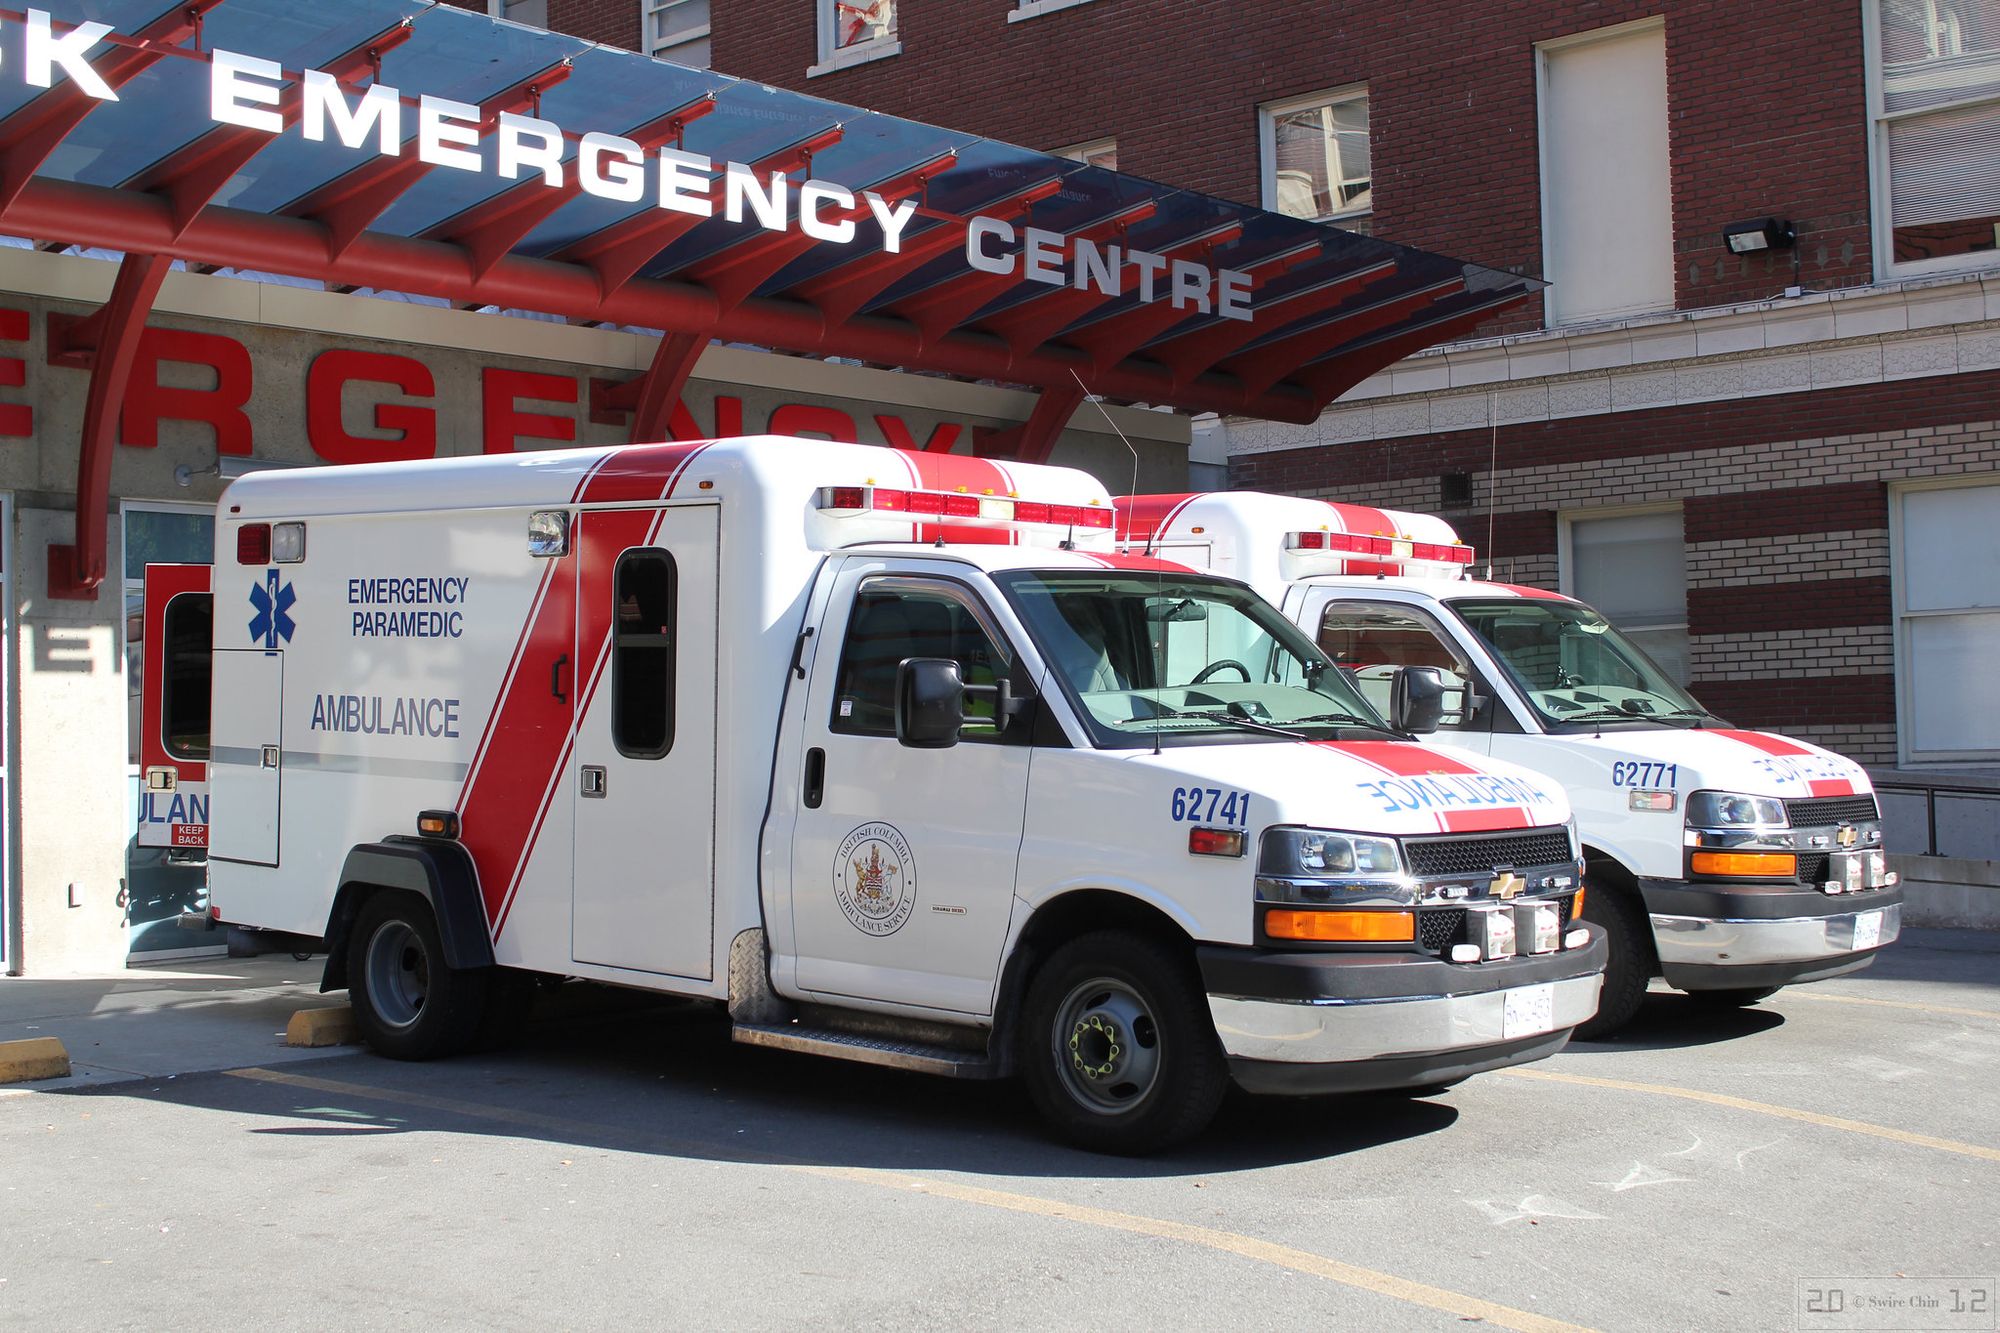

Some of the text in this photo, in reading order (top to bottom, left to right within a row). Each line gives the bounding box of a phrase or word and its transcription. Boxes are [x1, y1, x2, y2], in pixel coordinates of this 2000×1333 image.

[0, 6, 1254, 322] K EMERGENCY CENTRE
[348, 577, 469, 604] EMERGENCY
[352, 611, 463, 638] PARAMEDIC
[311, 694, 460, 738] AMBULANCE
[1613, 761, 1677, 788] 62771
[1171, 787, 1250, 826] 62741
[178, 836, 204, 844] BACK
[179, 826, 204, 834] KEEP
[841, 827, 909, 865] BRITISH COLUMBIA
[838, 889, 911, 932] AMBULANCE SERVICE
